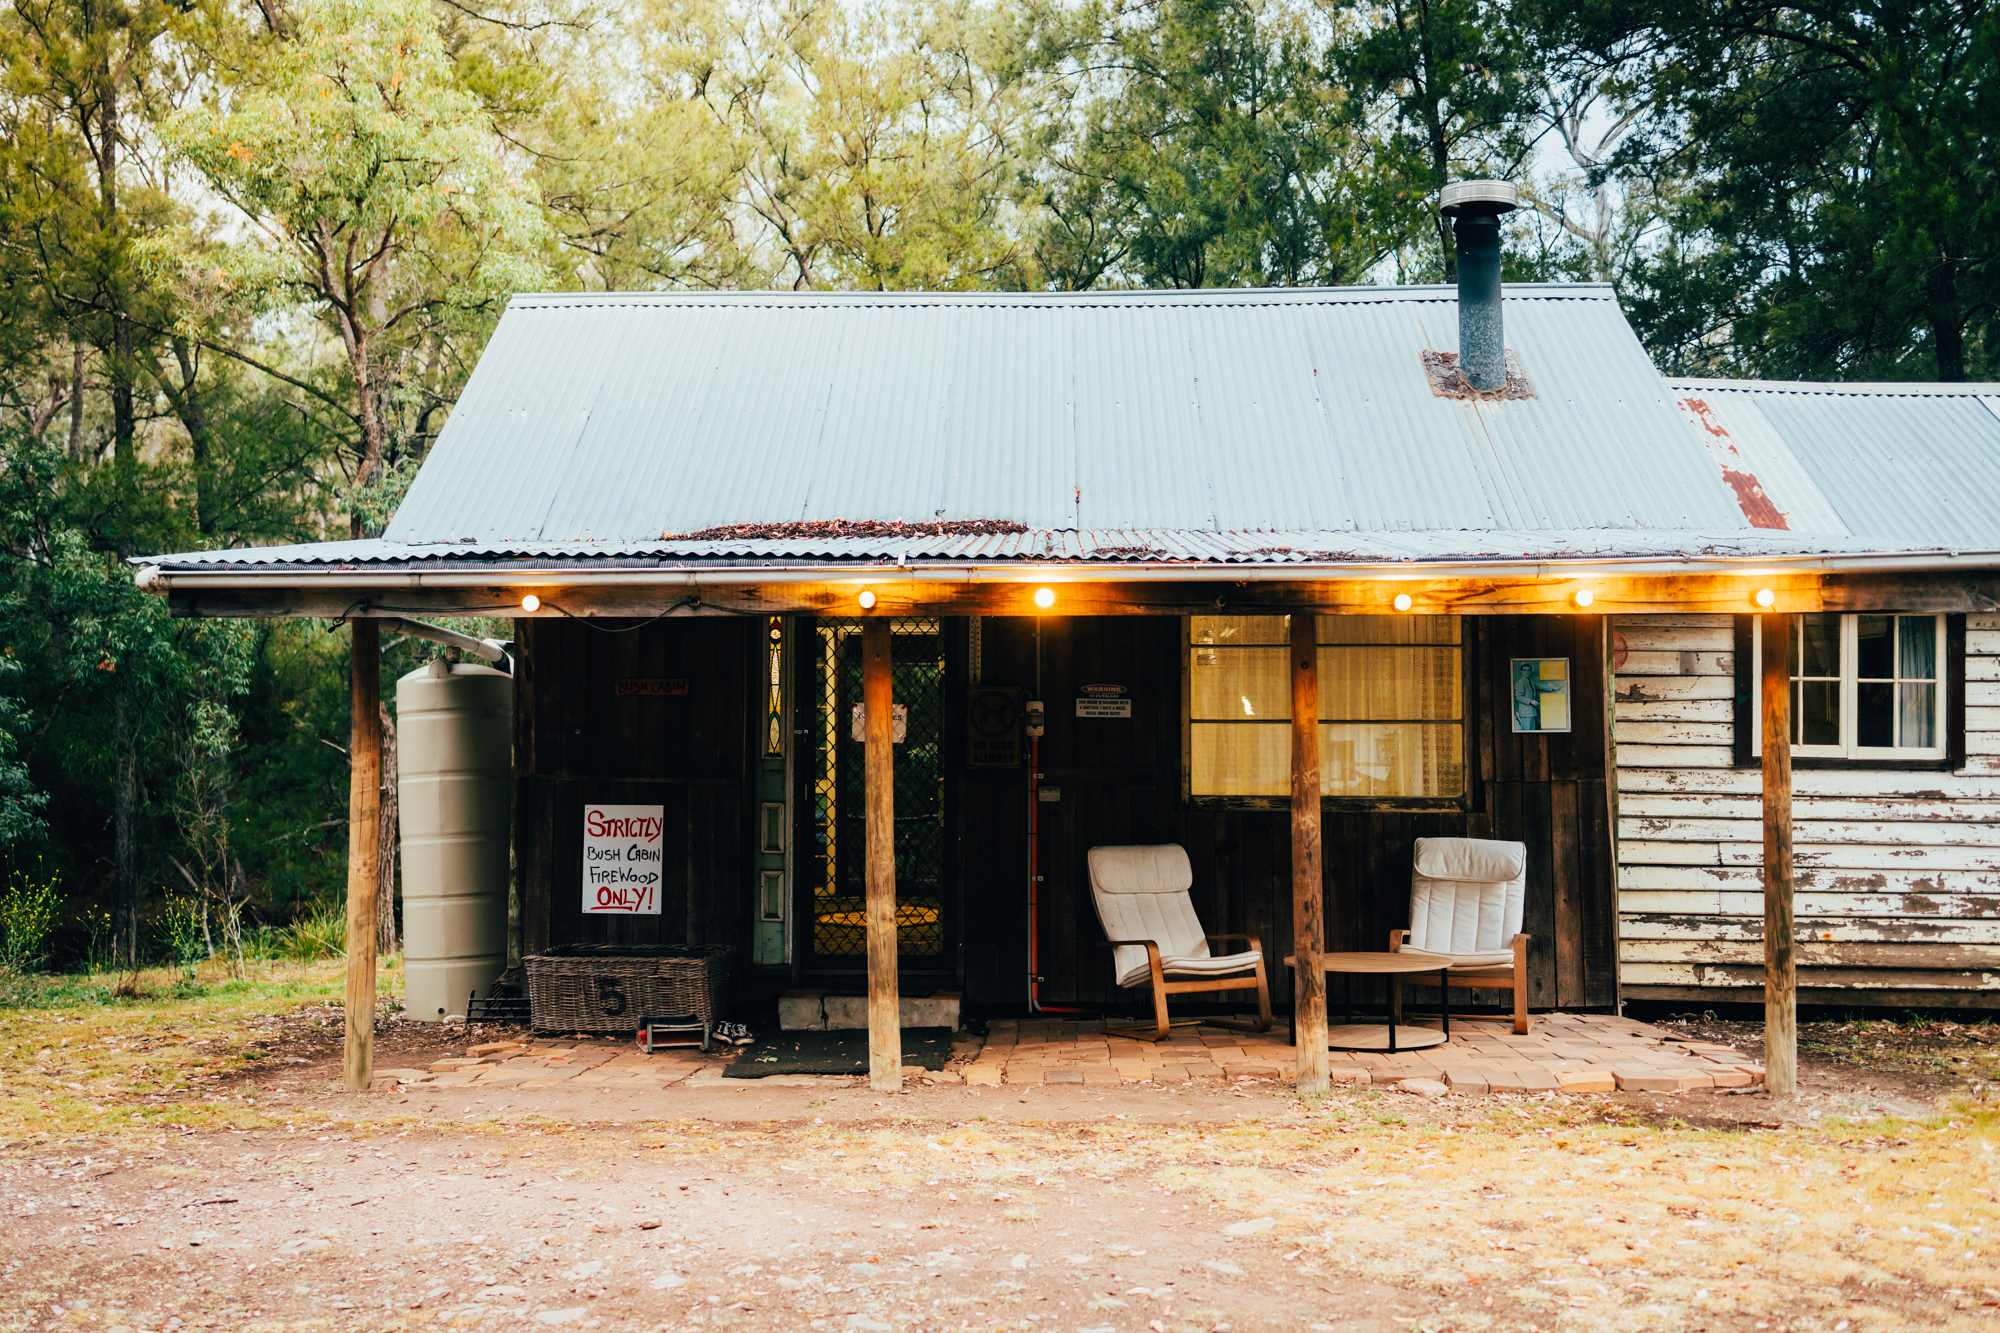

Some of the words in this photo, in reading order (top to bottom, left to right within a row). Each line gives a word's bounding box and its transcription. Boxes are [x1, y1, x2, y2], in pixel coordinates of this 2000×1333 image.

[587, 810, 663, 843] STRICTLY
[587, 846, 621, 861] BUSH
[627, 843, 661, 862] CABIN
[590, 866, 659, 885] FIREWOOD
[597, 886, 654, 912] ONLY!
[597, 976, 625, 1014] 5
